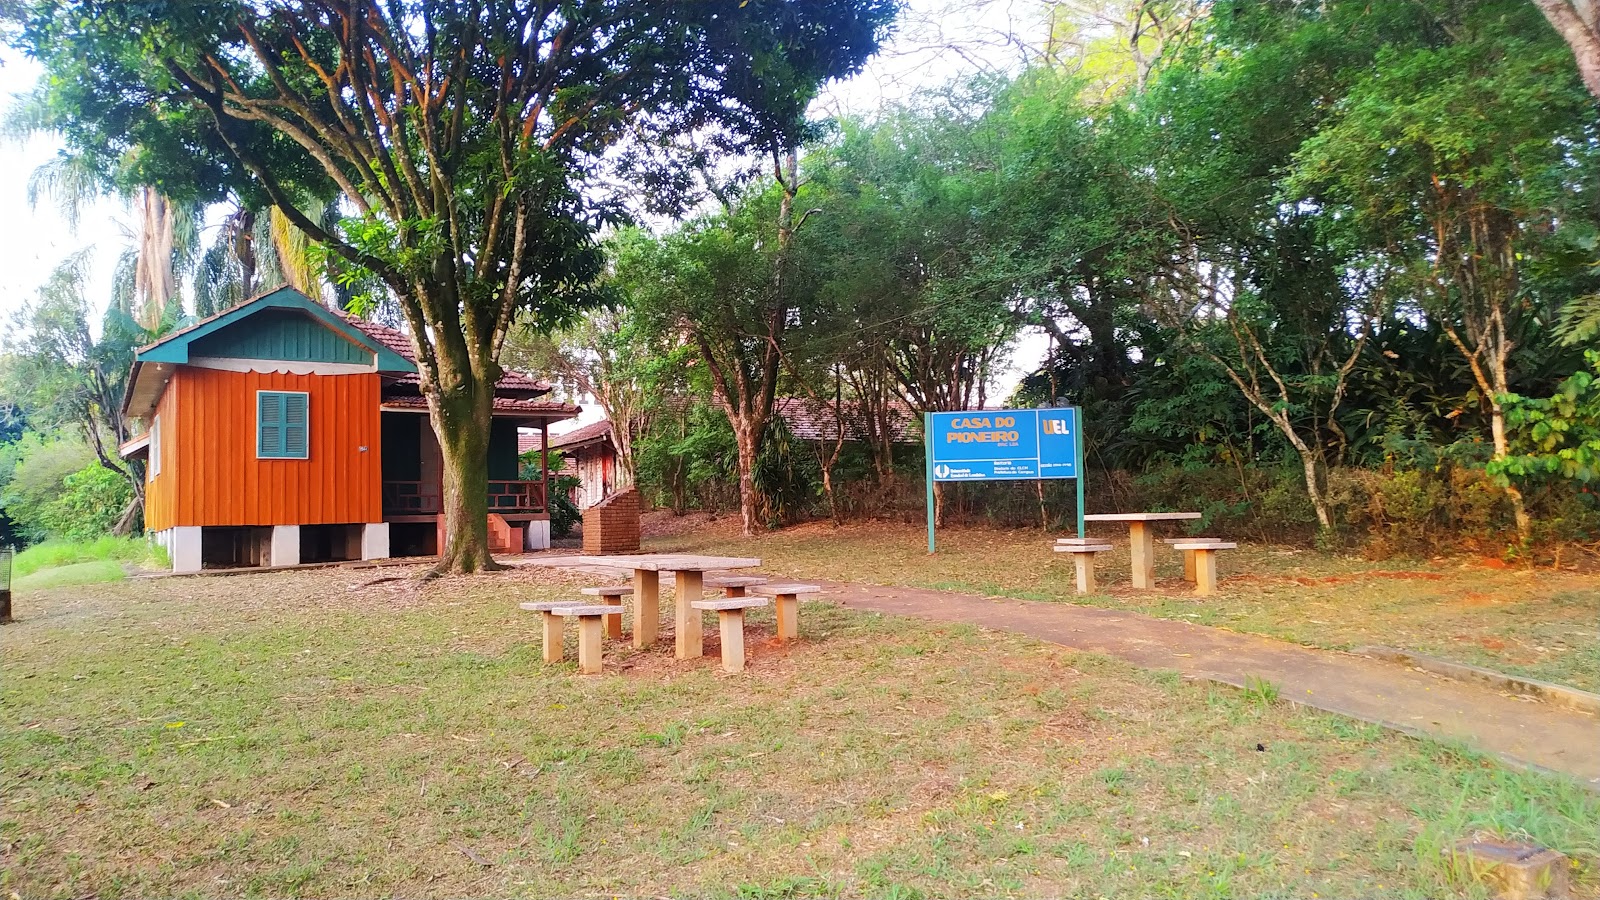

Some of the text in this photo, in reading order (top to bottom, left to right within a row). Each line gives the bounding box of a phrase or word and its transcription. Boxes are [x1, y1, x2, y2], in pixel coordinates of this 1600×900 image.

[951, 417, 1015, 429] CASA DO
[1042, 419, 1070, 435] UEL
[946, 430, 1019, 443] PIONEIRO
